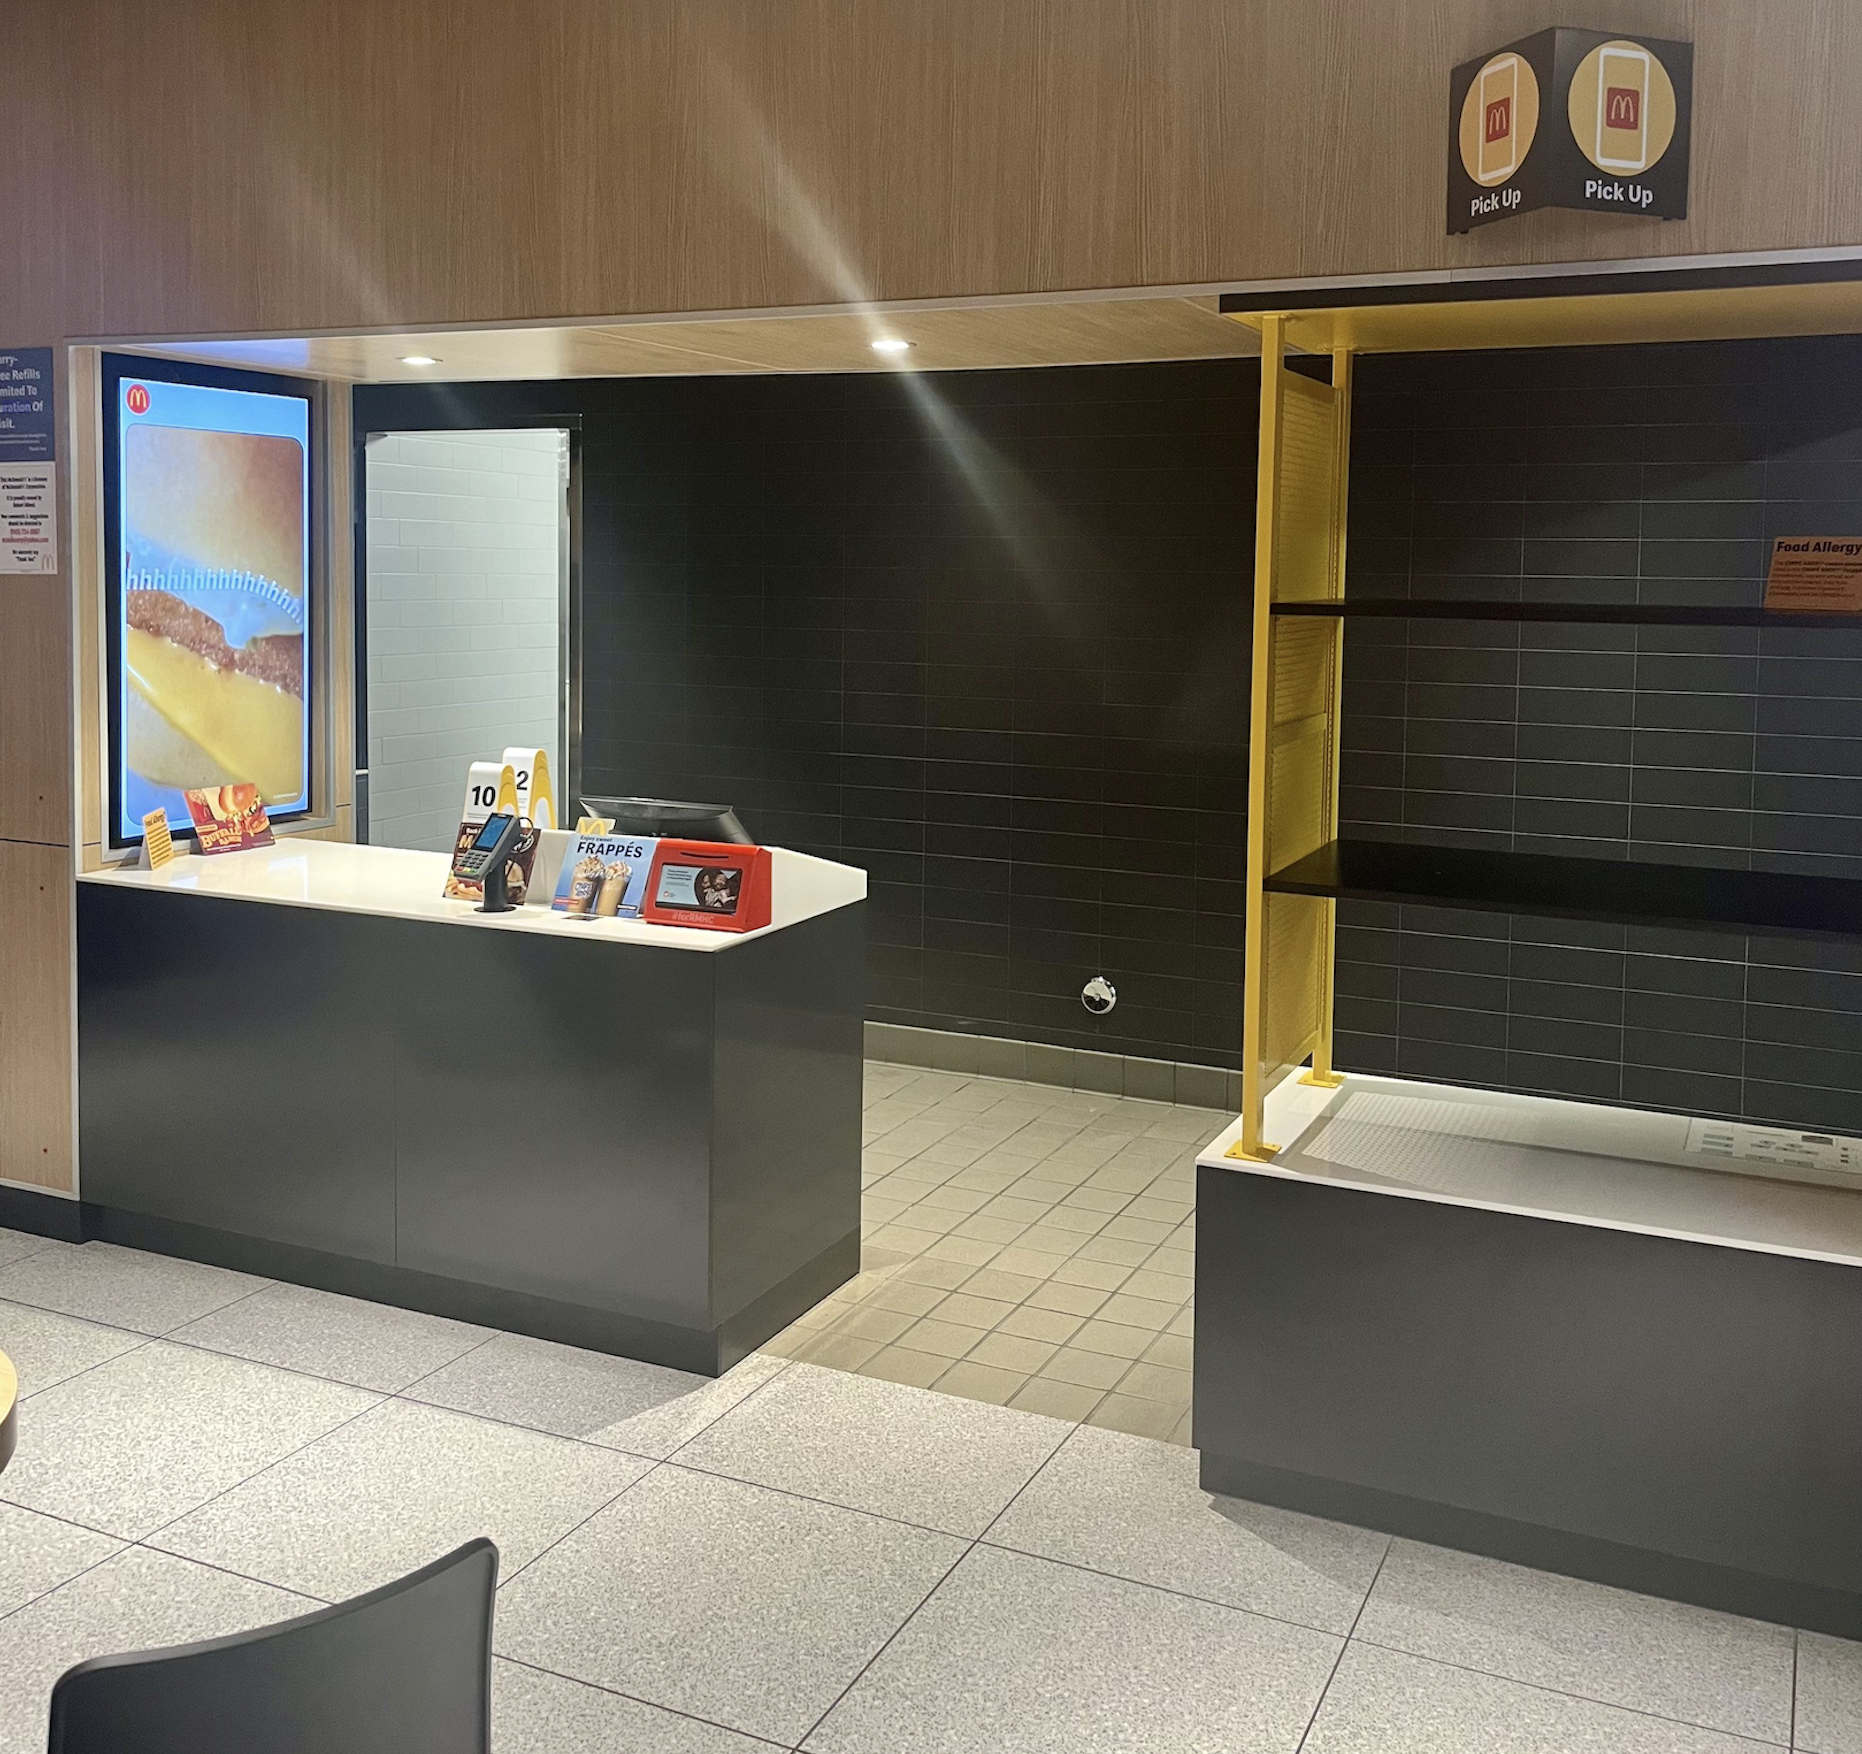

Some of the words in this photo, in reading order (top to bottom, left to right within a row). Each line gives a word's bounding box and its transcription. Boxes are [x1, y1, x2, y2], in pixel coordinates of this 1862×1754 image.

[1585, 180, 1624, 202] Pick
[1628, 184, 1653, 208] Up
[1471, 192, 1500, 217] Pick
[1502, 188, 1521, 209] Up
[12, 368, 40, 380] Refills
[26, 385, 37, 396] To
[32, 400, 43, 412] Of
[1777, 541, 1810, 552] Food
[1812, 541, 1862, 555] Allergy
[472, 786, 496, 807] 10
[577, 841, 643, 858] FRAPPÉS
